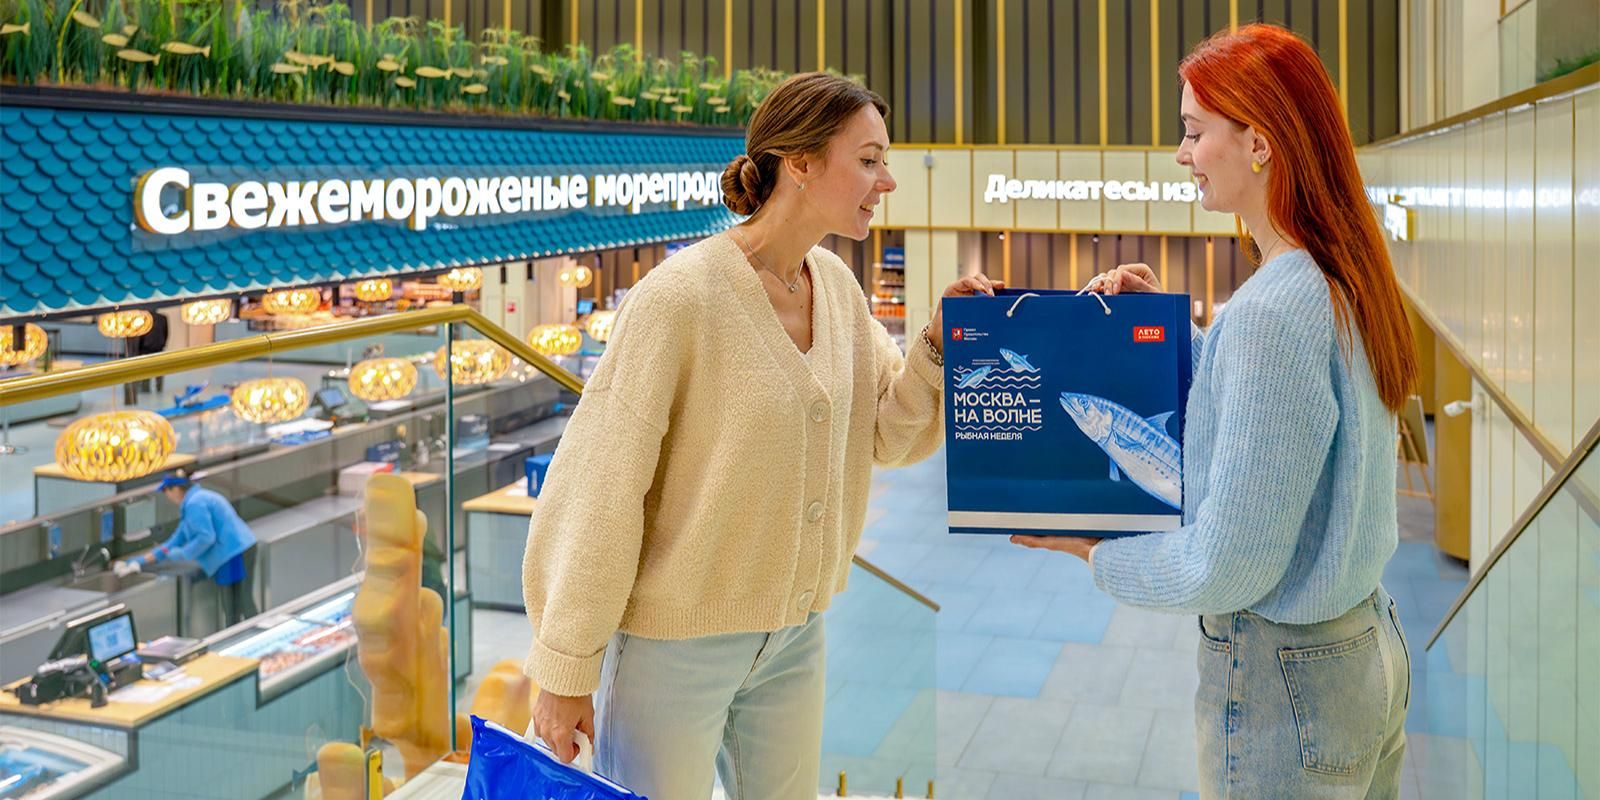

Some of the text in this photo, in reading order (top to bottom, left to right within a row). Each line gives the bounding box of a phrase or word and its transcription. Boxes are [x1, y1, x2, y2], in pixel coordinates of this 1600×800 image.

[984, 174, 1160, 203] Деликатесы
[140, 167, 726, 233] Свежемороженые морепрод
[1138, 328, 1160, 336] ЛЕТО
[953, 392, 1027, 407] МОСКВА
[954, 409, 1042, 424] НА ВОЛНЕ
[955, 432, 1023, 440] РЫБНАЯ НЕДЕЛЯ
